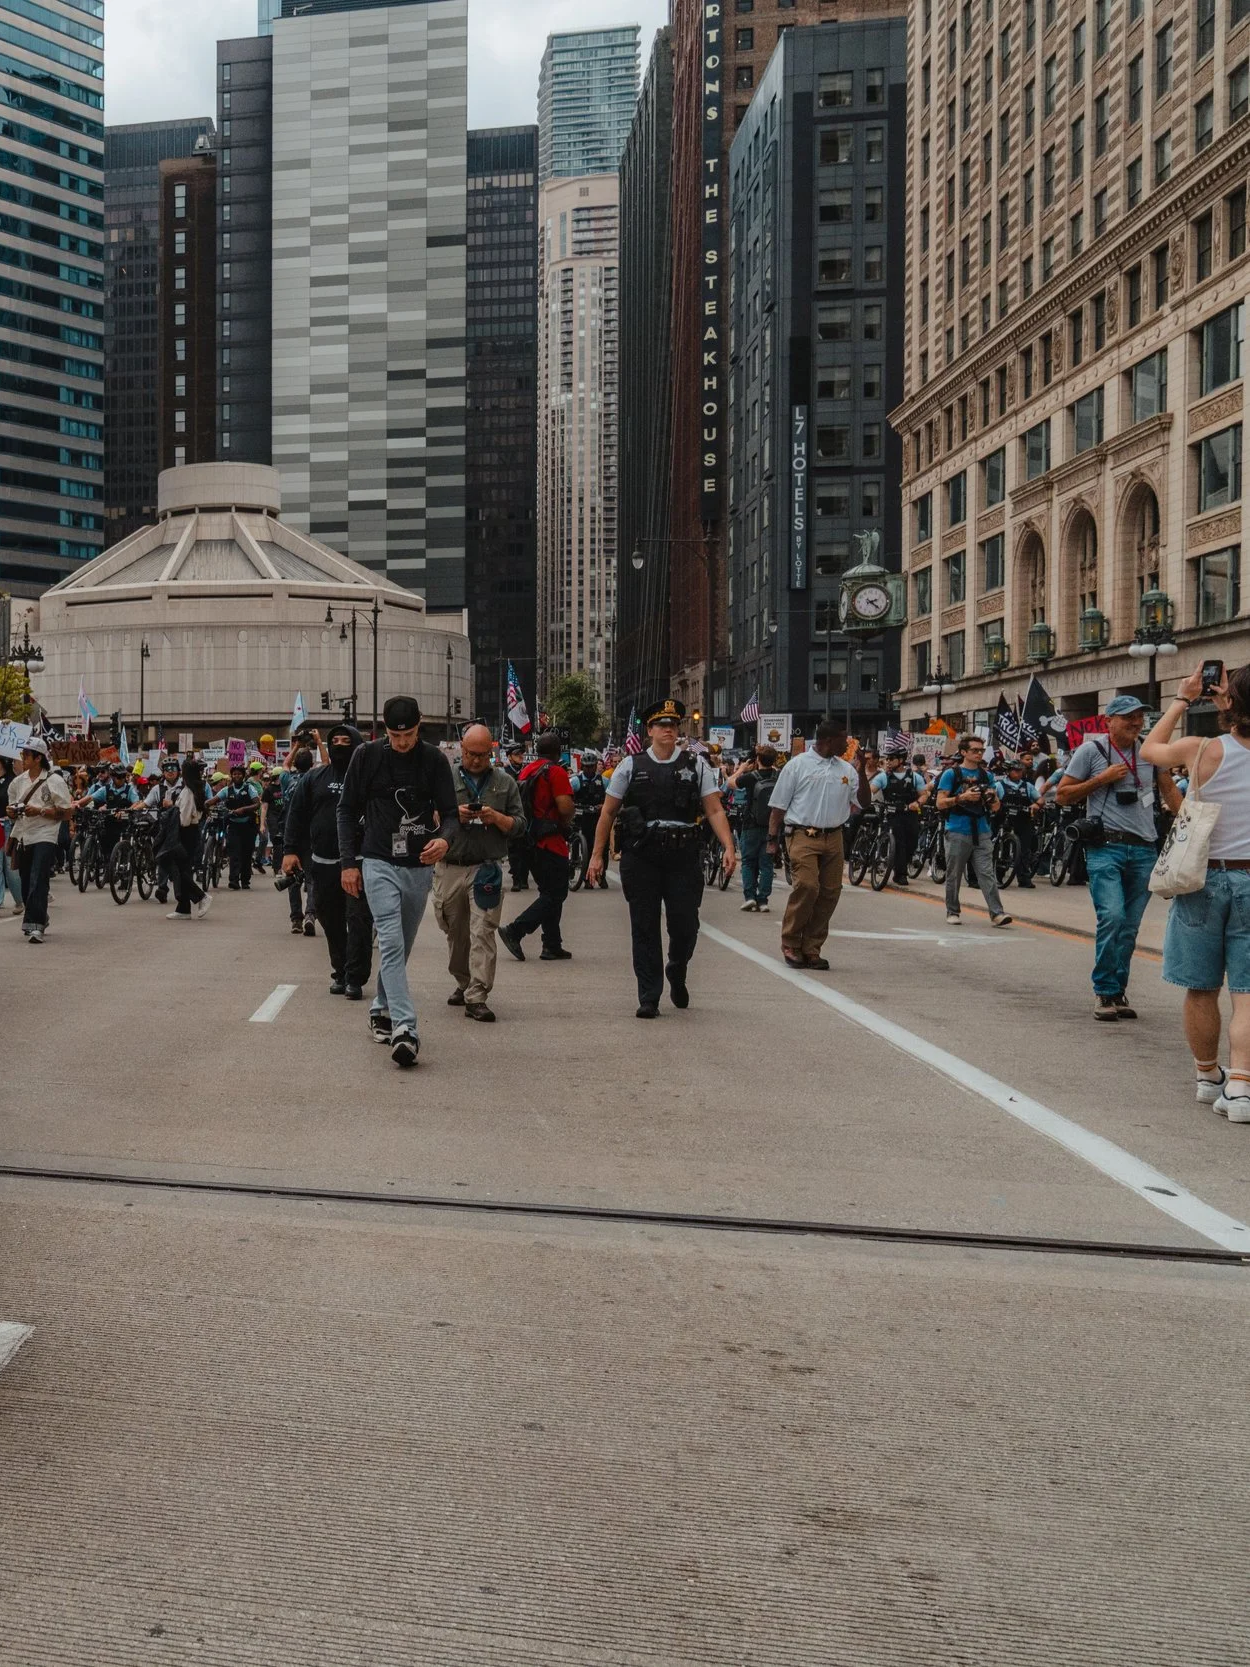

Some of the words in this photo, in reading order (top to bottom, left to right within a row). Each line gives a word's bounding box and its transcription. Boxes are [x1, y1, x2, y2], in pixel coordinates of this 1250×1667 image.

[704, 158, 719, 224] THE
[702, 249, 719, 493] STEAKHOUSE
[794, 406, 805, 435] L7
[791, 442, 807, 531] HOTELS
[795, 536, 802, 550] BY
[794, 553, 803, 589] LOTTE
[236, 629, 348, 645] CHURC
[1064, 667, 1102, 686] WACKER
[1107, 660, 1139, 679] DRIVE
[71, 749, 100, 761] KINGS
[79, 741, 95, 750] NO
[231, 741, 242, 749] NO
